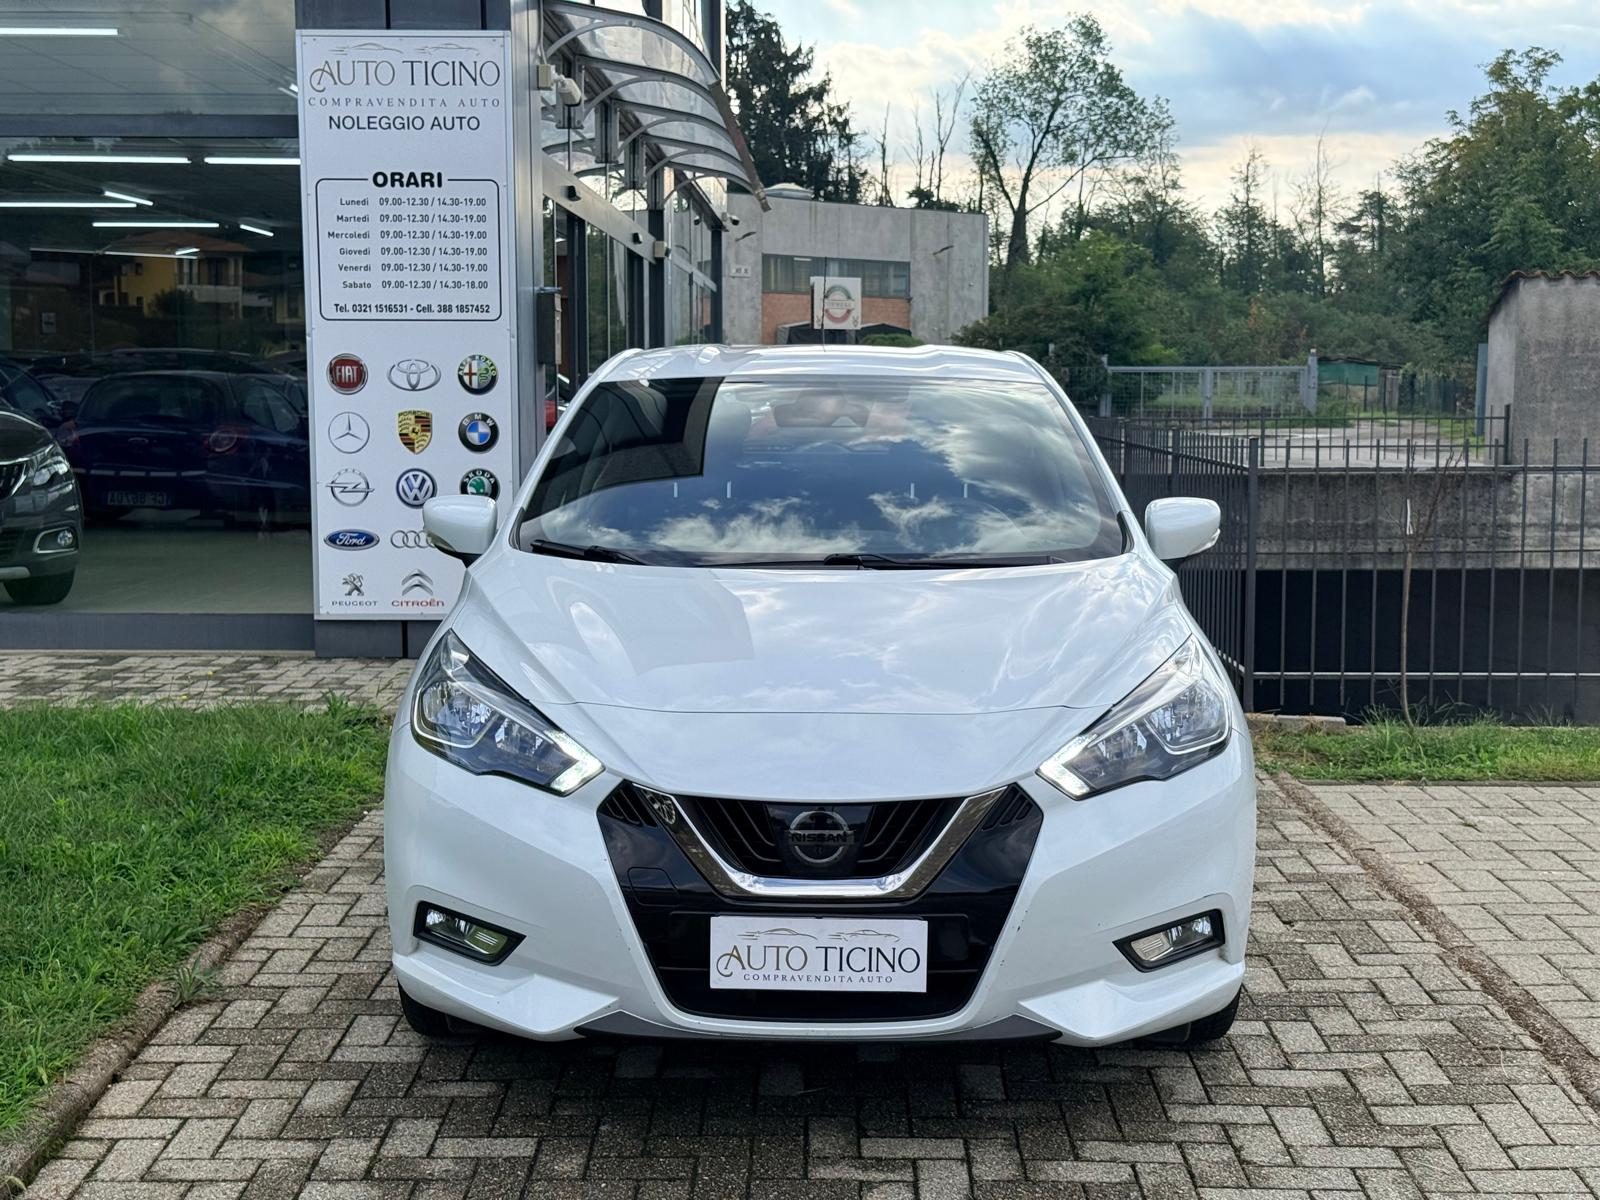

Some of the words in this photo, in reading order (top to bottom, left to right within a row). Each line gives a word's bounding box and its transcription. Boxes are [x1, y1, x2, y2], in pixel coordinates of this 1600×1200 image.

[309, 60, 396, 93] AUTO
[402, 60, 500, 87] TICINO
[308, 97, 448, 108] COMPRAVENDITA
[458, 98, 500, 108] AUTO
[328, 115, 425, 131] NOLEGGIO
[430, 116, 481, 131] AUTO
[372, 171, 443, 188] ORARI
[379, 197, 429, 206] 09.00-12.30
[437, 197, 487, 206] 14.30-19.00
[379, 214, 430, 223] 09.00-12.30
[437, 214, 487, 223] 14.30-19.00
[380, 230, 430, 239] 09.00-12.30
[438, 230, 488, 239] 14.30-19.00
[380, 247, 430, 256] 09.00-12.30
[438, 247, 488, 256] 14.30-19.00
[381, 263, 431, 272] 09.00-12.30
[439, 263, 488, 272] 14.30-19.00
[342, 280, 372, 289] Sabato
[381, 280, 431, 289] 09.00-12.30
[439, 280, 489, 289] 14.30-18.00
[333, 303, 350, 313] Tel.
[352, 303, 372, 313] 0321
[375, 303, 408, 313] 1516531
[416, 304, 435, 313] Cell.
[437, 304, 453, 313] 388
[455, 304, 490, 313] 1857452
[335, 365, 358, 383] FIAT
[462, 413, 495, 426] BMW
[336, 533, 367, 546] Ford
[791, 833, 848, 843] NISSAN
[716, 944, 808, 977] AUTO
[816, 946, 921, 974] TICINO
[743, 973, 853, 984] COMPRAVENDITA
[858, 976, 893, 984] AUTO
